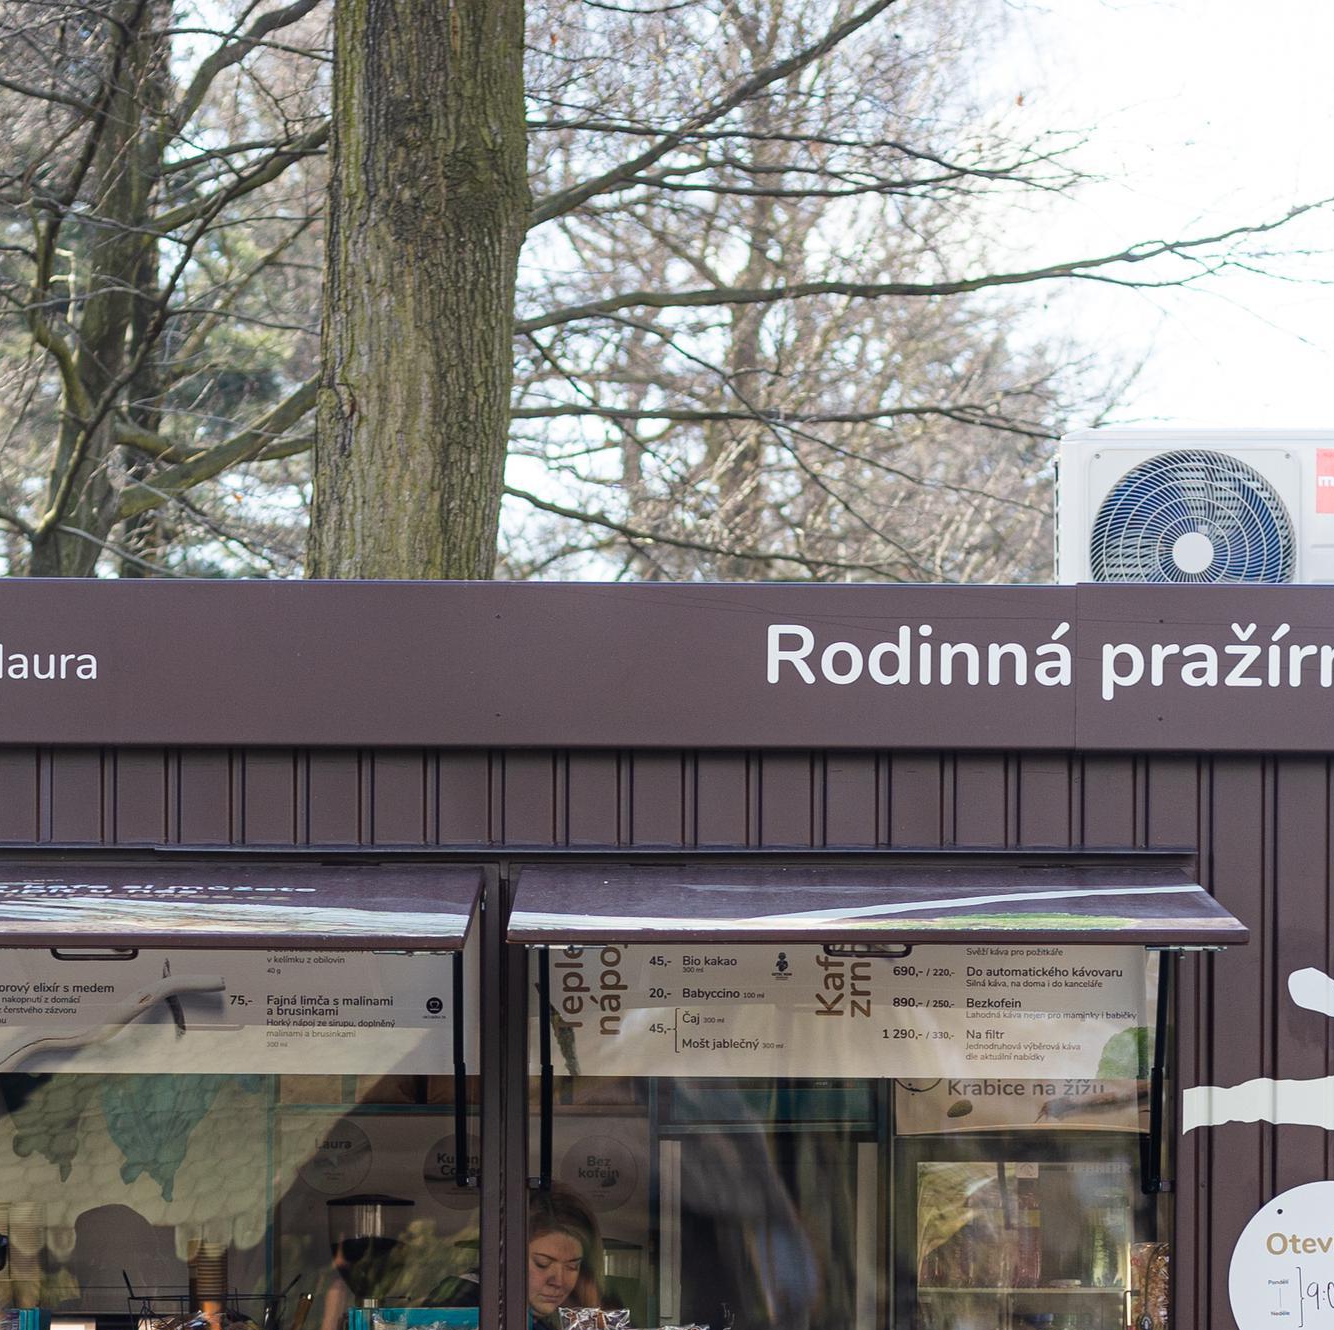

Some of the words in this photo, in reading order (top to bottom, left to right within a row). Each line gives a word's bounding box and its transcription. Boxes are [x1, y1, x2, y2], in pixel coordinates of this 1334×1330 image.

[765, 620, 1072, 687] Rodinná
[966, 947, 990, 957] Svěží
[992, 948, 1009, 956] káva
[1026, 947, 1063, 957] požitkáře
[274, 955, 305, 964] kelímku
[313, 955, 346, 964] obilovin
[649, 956, 672, 967] 45,-
[682, 956, 700, 966] Bio
[704, 956, 737, 966] kakao
[893, 967, 923, 978] 690,-
[933, 968, 955, 978] 220,-
[966, 967, 982, 977] Do
[986, 966, 1068, 977] automatického
[1072, 966, 1123, 977] kávovaru
[33, 982, 60, 993] elixír
[62, 985, 69, 993] s
[72, 983, 115, 993] medem
[966, 979, 986, 988] Silná
[988, 979, 1009, 989] káva,
[1024, 979, 1045, 988] doma
[1052, 979, 1062, 988] do
[1064, 978, 1102, 988] kanceláře
[2, 995, 42, 1006] nakopnutí
[51, 994, 81, 1004] domácí
[649, 988, 672, 1000] 20,-
[682, 988, 740, 1001] Babyccino
[230, 995, 253, 1006] 75,-
[267, 994, 297, 1008] Fajná
[300, 994, 330, 1006] limča
[333, 998, 339, 1006] s
[342, 995, 394, 1006] malinami
[892, 998, 923, 1009] 890,-
[933, 999, 955, 1009] 250,-
[966, 997, 1022, 1009] Bezkofein
[3, 1005, 42, 1014] čerstvého
[45, 1005, 77, 1014] zázvoru
[276, 1006, 339, 1016] brusinkami
[682, 1011, 700, 1026] Čaj
[966, 1010, 1000, 1020] Lahodná
[1003, 1010, 1022, 1019] káva
[1024, 1011, 1046, 1021] nejen
[1048, 1013, 1061, 1021] pro
[1063, 1011, 1100, 1021] maminky
[1106, 1010, 1138, 1021] babičky
[267, 1018, 291, 1029] Horký
[293, 1018, 316, 1029] nápoj
[358, 1018, 396, 1029] doplněný
[267, 1030, 304, 1038] malinami
[312, 1030, 356, 1038] brusinkami
[933, 1031, 955, 1041] 330,-
[966, 1030, 982, 1039] Na
[985, 1029, 1004, 1039] filtr
[682, 1038, 709, 1049] Mošt
[711, 1038, 759, 1052] jablečný
[965, 1042, 1022, 1051] Jednodruhová
[1023, 1041, 1060, 1053] výběrová
[1062, 1042, 1081, 1051] káva
[966, 1053, 977, 1061] dle
[979, 1053, 1012, 1061] aktuální
[1013, 1053, 1045, 1064] nabídky
[948, 1080, 1025, 1096] Krabice
[1032, 1084, 1056, 1096] na
[586, 1155, 612, 1167] Bez
